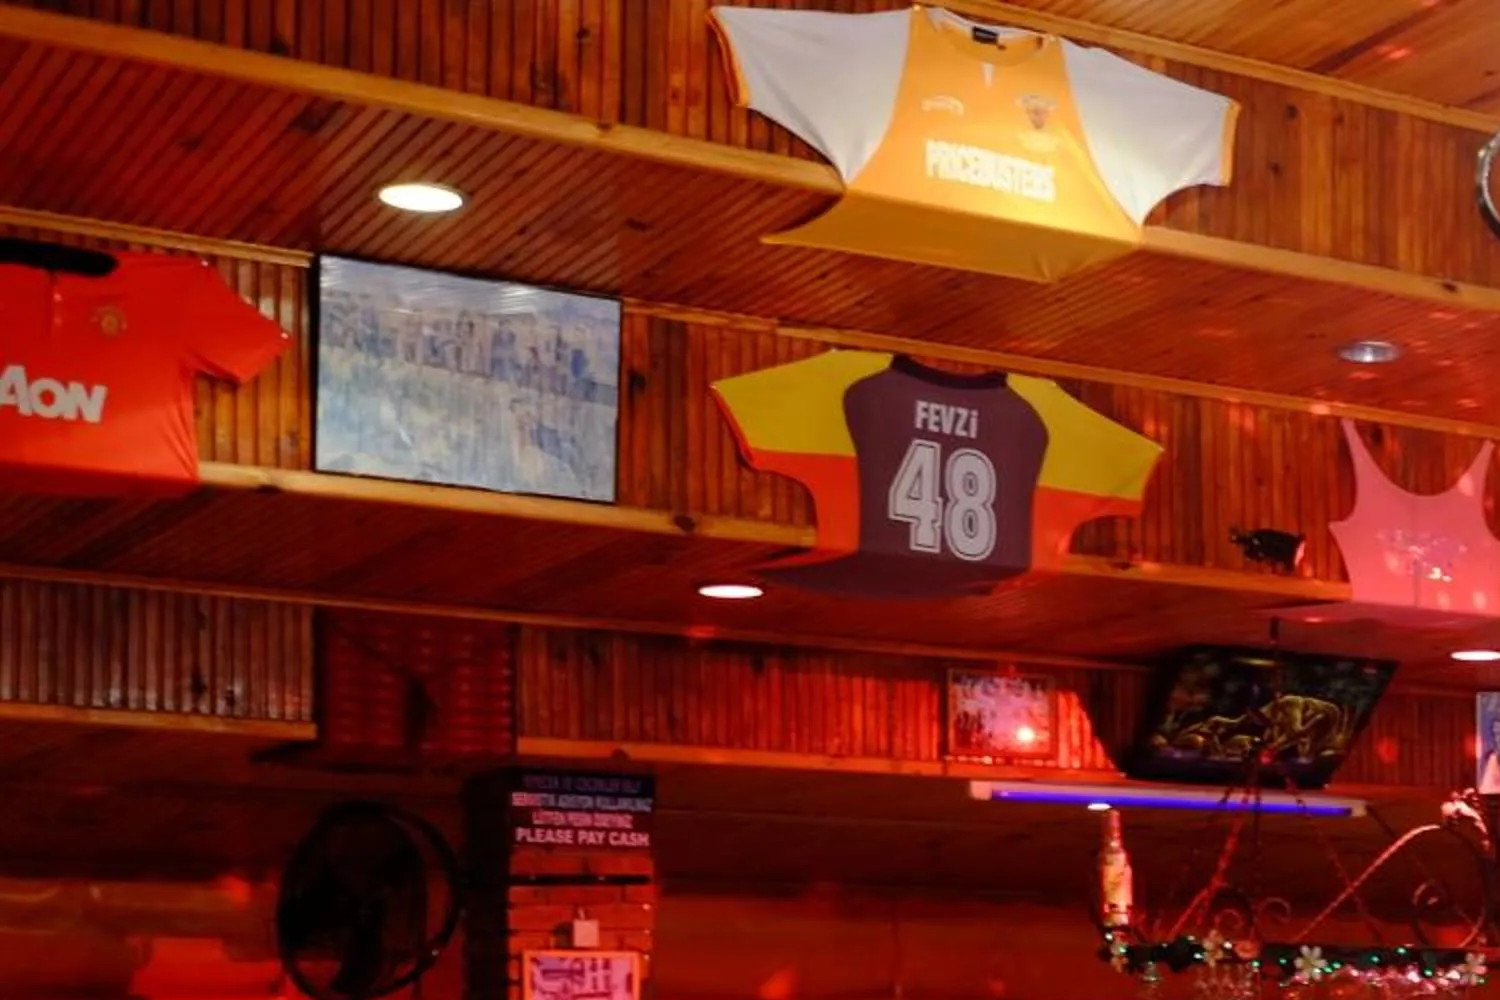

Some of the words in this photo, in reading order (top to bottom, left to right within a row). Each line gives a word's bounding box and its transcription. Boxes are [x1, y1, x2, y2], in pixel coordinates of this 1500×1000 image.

[926, 139, 1056, 203] PRICEBUSTERS
[0, 364, 108, 423] AON
[888, 438, 997, 561] 48
[515, 827, 574, 844] PLEASE
[578, 830, 606, 846] PAY
[609, 832, 650, 847] CASH
